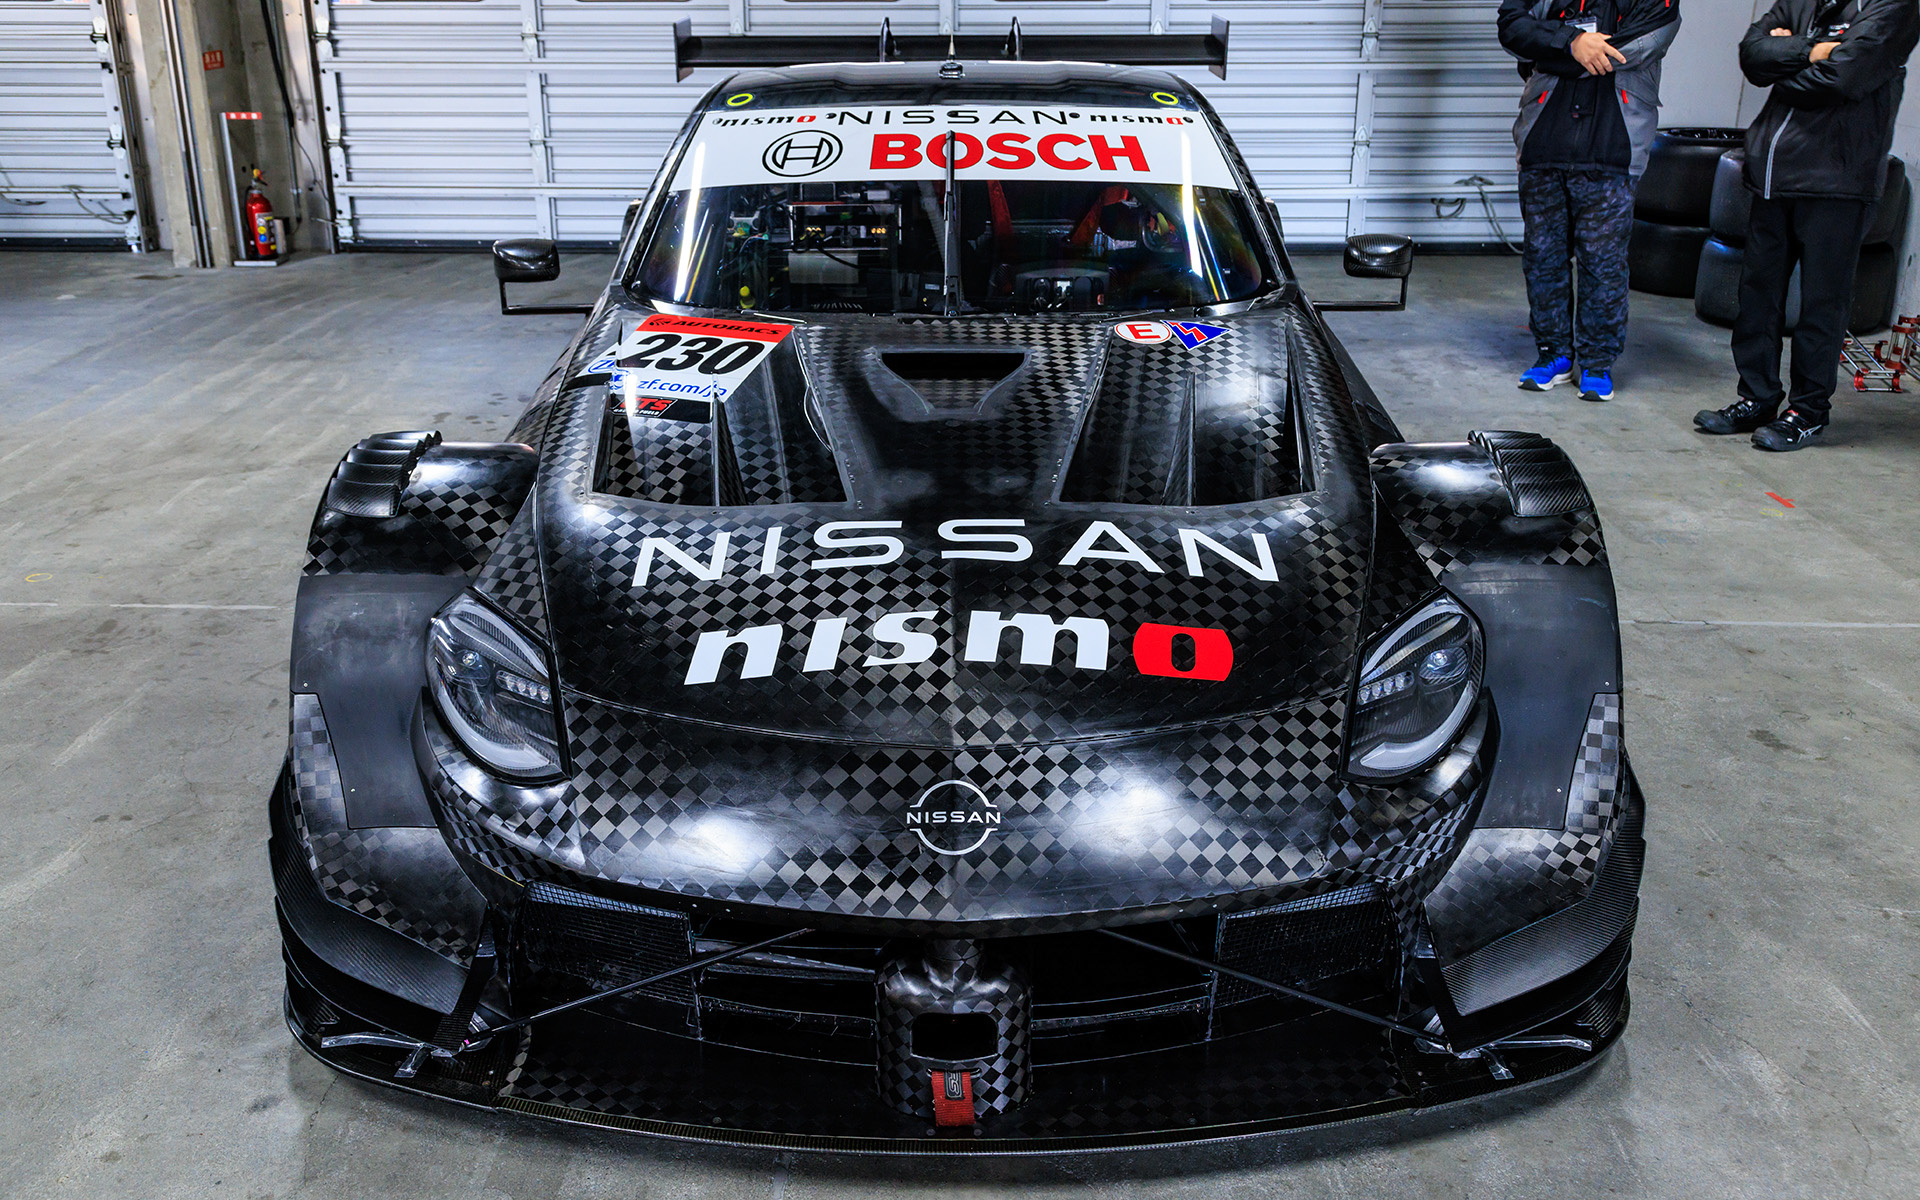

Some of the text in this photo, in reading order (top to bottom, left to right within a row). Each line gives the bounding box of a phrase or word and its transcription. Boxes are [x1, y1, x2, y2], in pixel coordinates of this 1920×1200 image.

[720, 110, 1184, 127] nismo NISSAN nismo
[869, 132, 1151, 173] BOSCH
[672, 319, 782, 335] AUTOBACS
[615, 333, 766, 375] 230
[631, 519, 1280, 588] NISSAN
[683, 609, 1234, 686] nismo
[906, 811, 1001, 824] NISSAN
